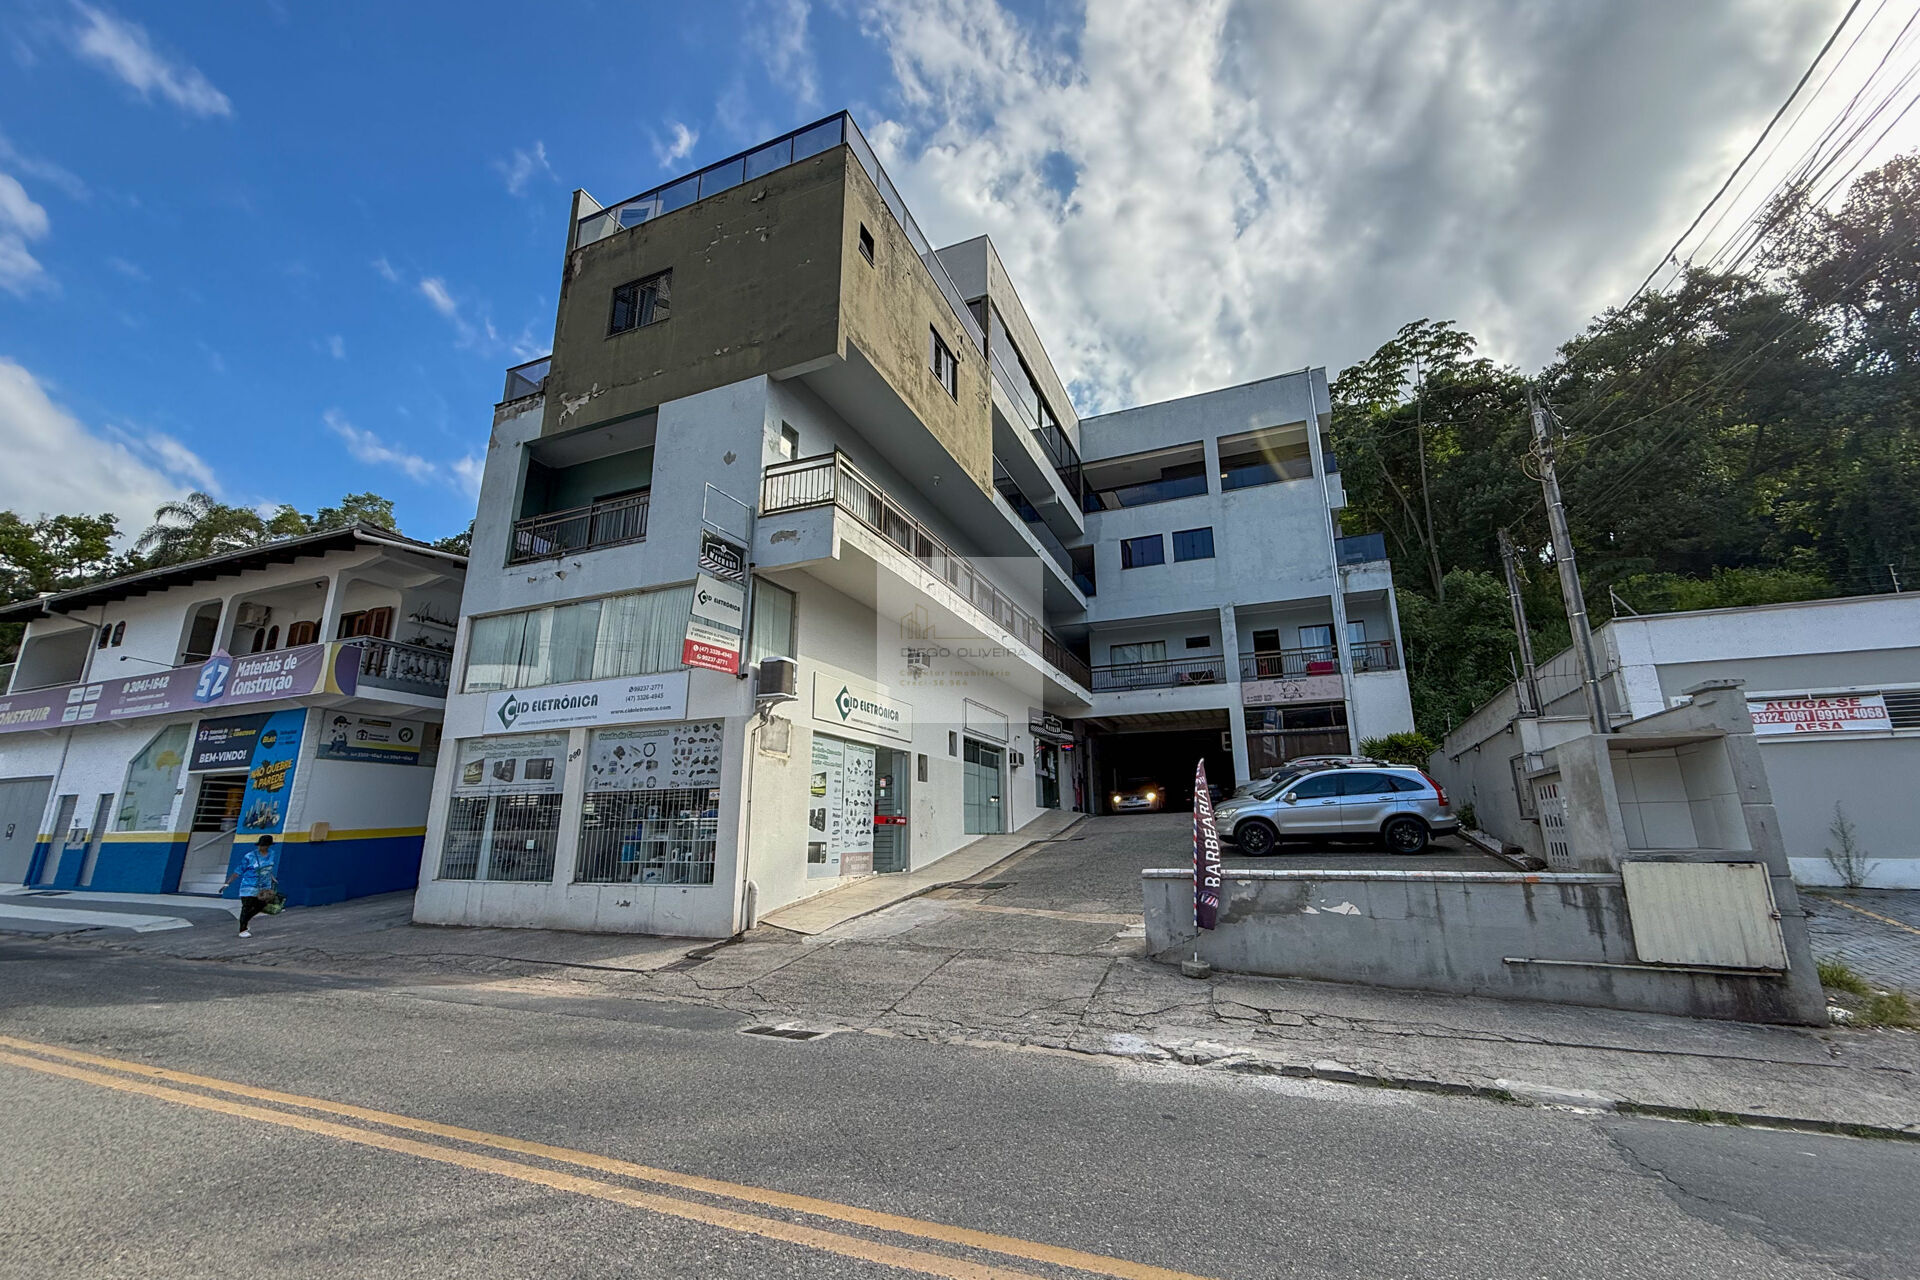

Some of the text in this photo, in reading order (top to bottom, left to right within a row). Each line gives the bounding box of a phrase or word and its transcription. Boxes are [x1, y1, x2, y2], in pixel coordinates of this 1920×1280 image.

[235, 653, 298, 677] Materiais de
[230, 670, 293, 696] Construção
[633, 683, 664, 693] 99237-2771
[531, 694, 599, 713] ELETRÔNICA
[625, 692, 664, 703] (47) 3326-4945
[1765, 697, 1862, 711] ALUGA-SE
[860, 700, 899, 722] ELETRÔNICA
[1752, 706, 1884, 724] 3322-0091 99141-4068
[198, 749, 247, 764] BEM-VINDO!
[1195, 789, 1222, 889] BARBEARIA
